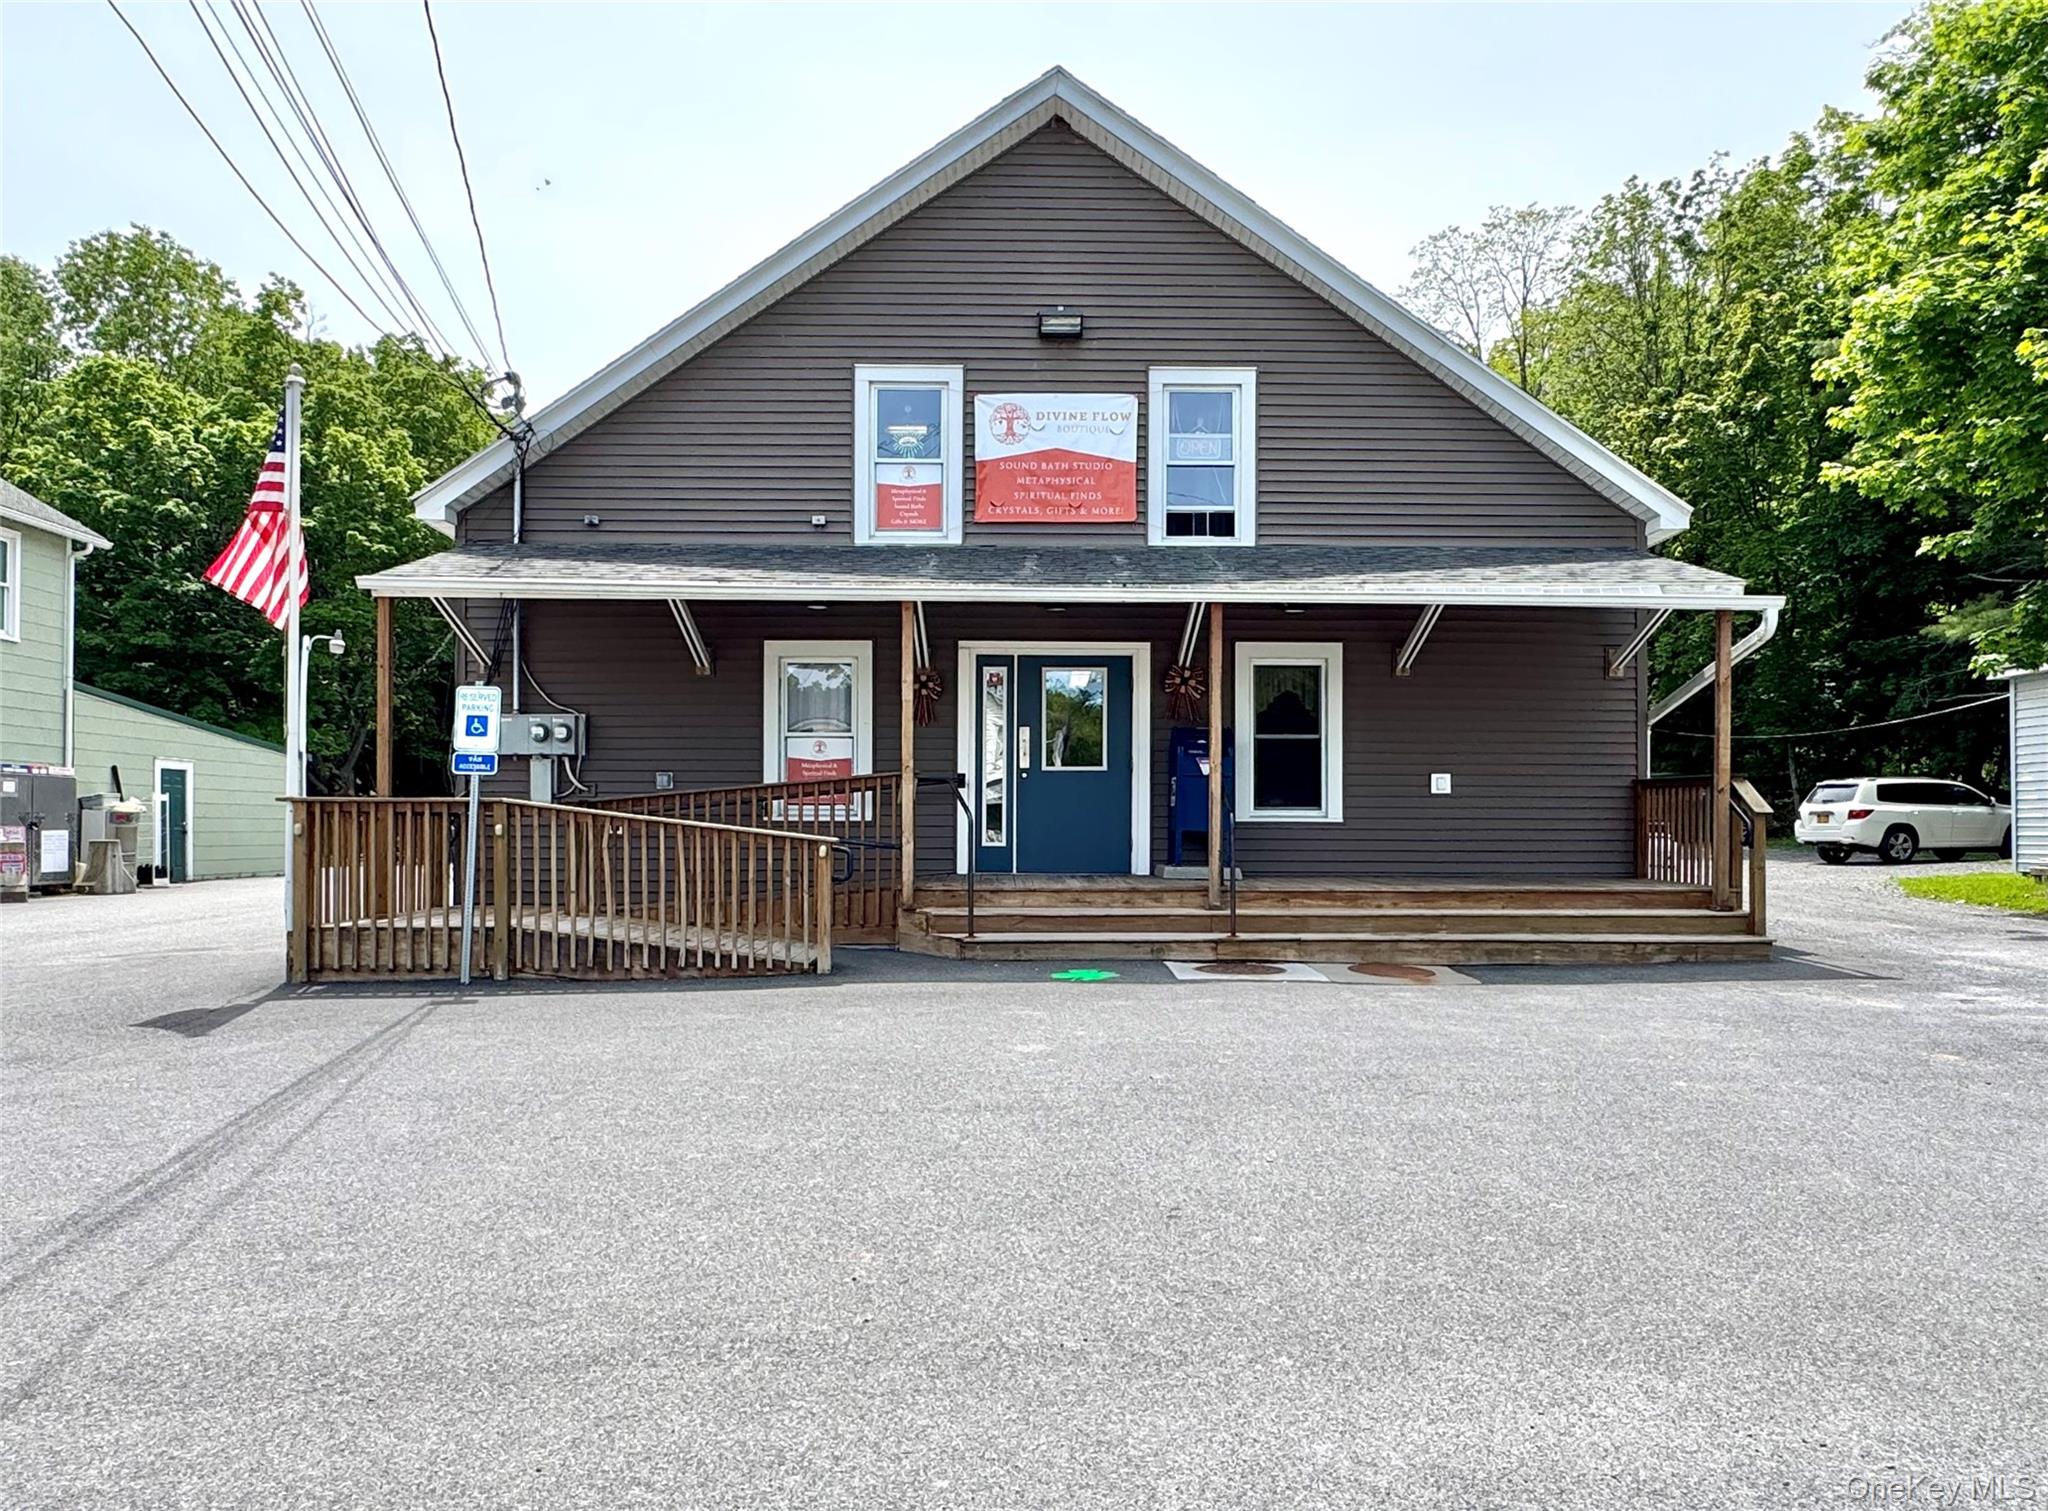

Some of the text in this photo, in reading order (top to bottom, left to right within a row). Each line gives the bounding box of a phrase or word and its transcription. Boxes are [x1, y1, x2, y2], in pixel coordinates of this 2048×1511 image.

[1036, 411, 1132, 421] DIVINE FLOW
[1179, 439, 1218, 454] OPEN
[999, 461, 1113, 470] SOUND BATH STUDIO
[1016, 476, 1096, 486] METAPHYSICAL
[1014, 491, 1102, 500] SPIRITUAL FINDS
[988, 506, 1043, 516] CRYSTALS,
[1046, 506, 1076, 516] GIFTS
[1079, 506, 1088, 515] &
[460, 693, 497, 702] RESERVED
[461, 703, 495, 712] PARKING
